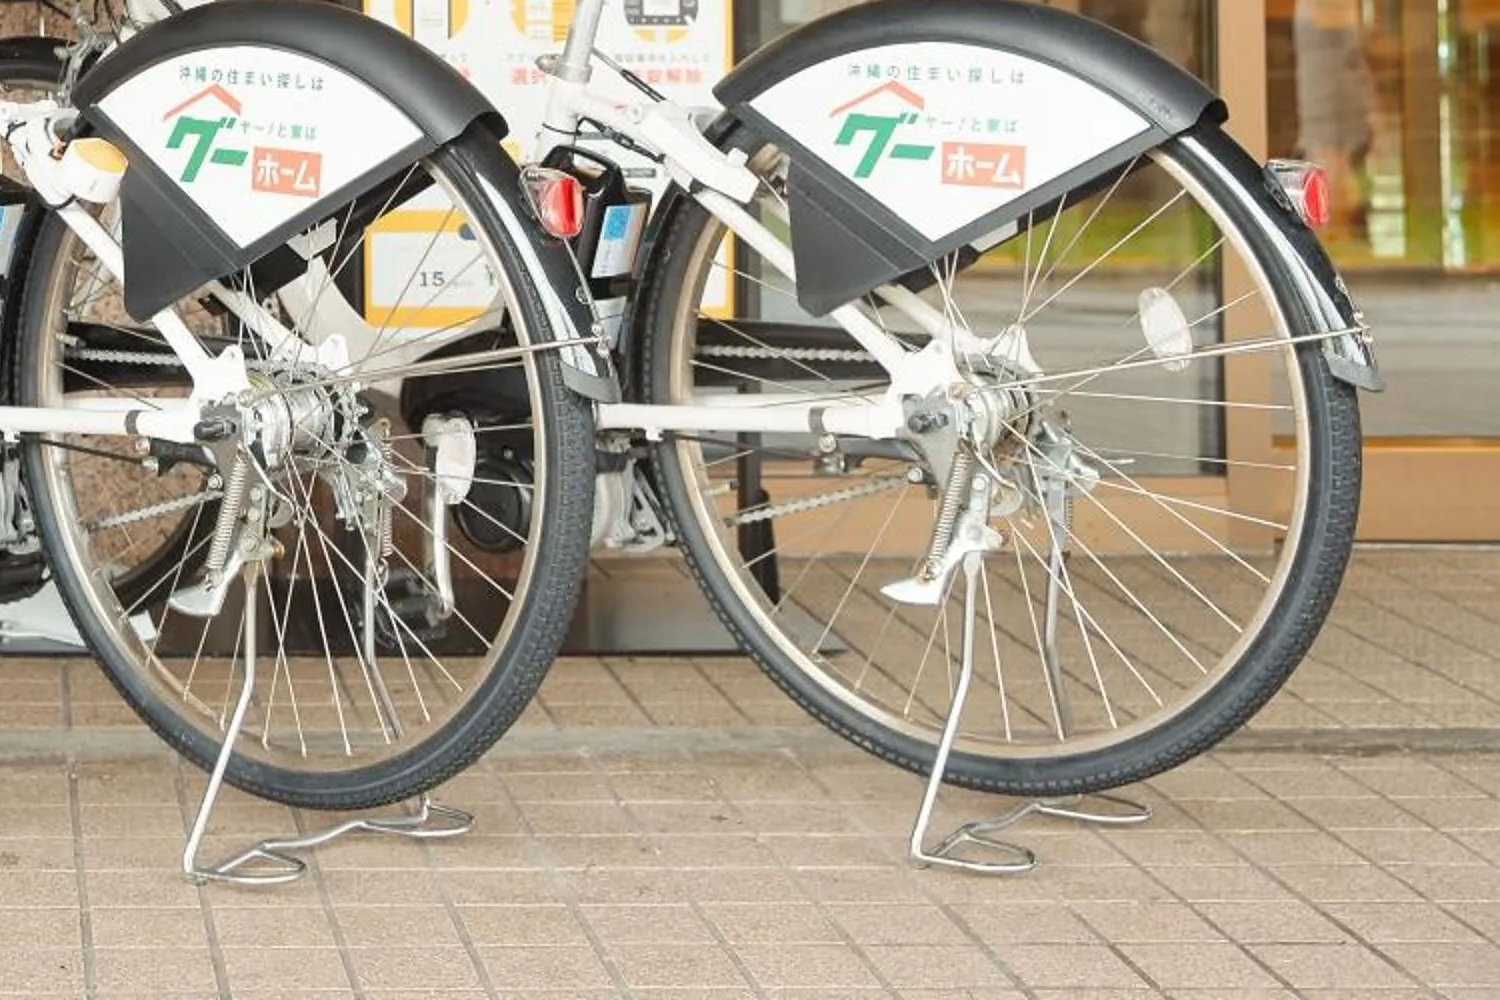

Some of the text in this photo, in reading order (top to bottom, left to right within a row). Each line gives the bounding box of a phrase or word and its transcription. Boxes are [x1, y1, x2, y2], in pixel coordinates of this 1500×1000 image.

[256, 155, 317, 192] ホーム
[946, 144, 1021, 184] ホーム
[418, 270, 446, 288] 15
